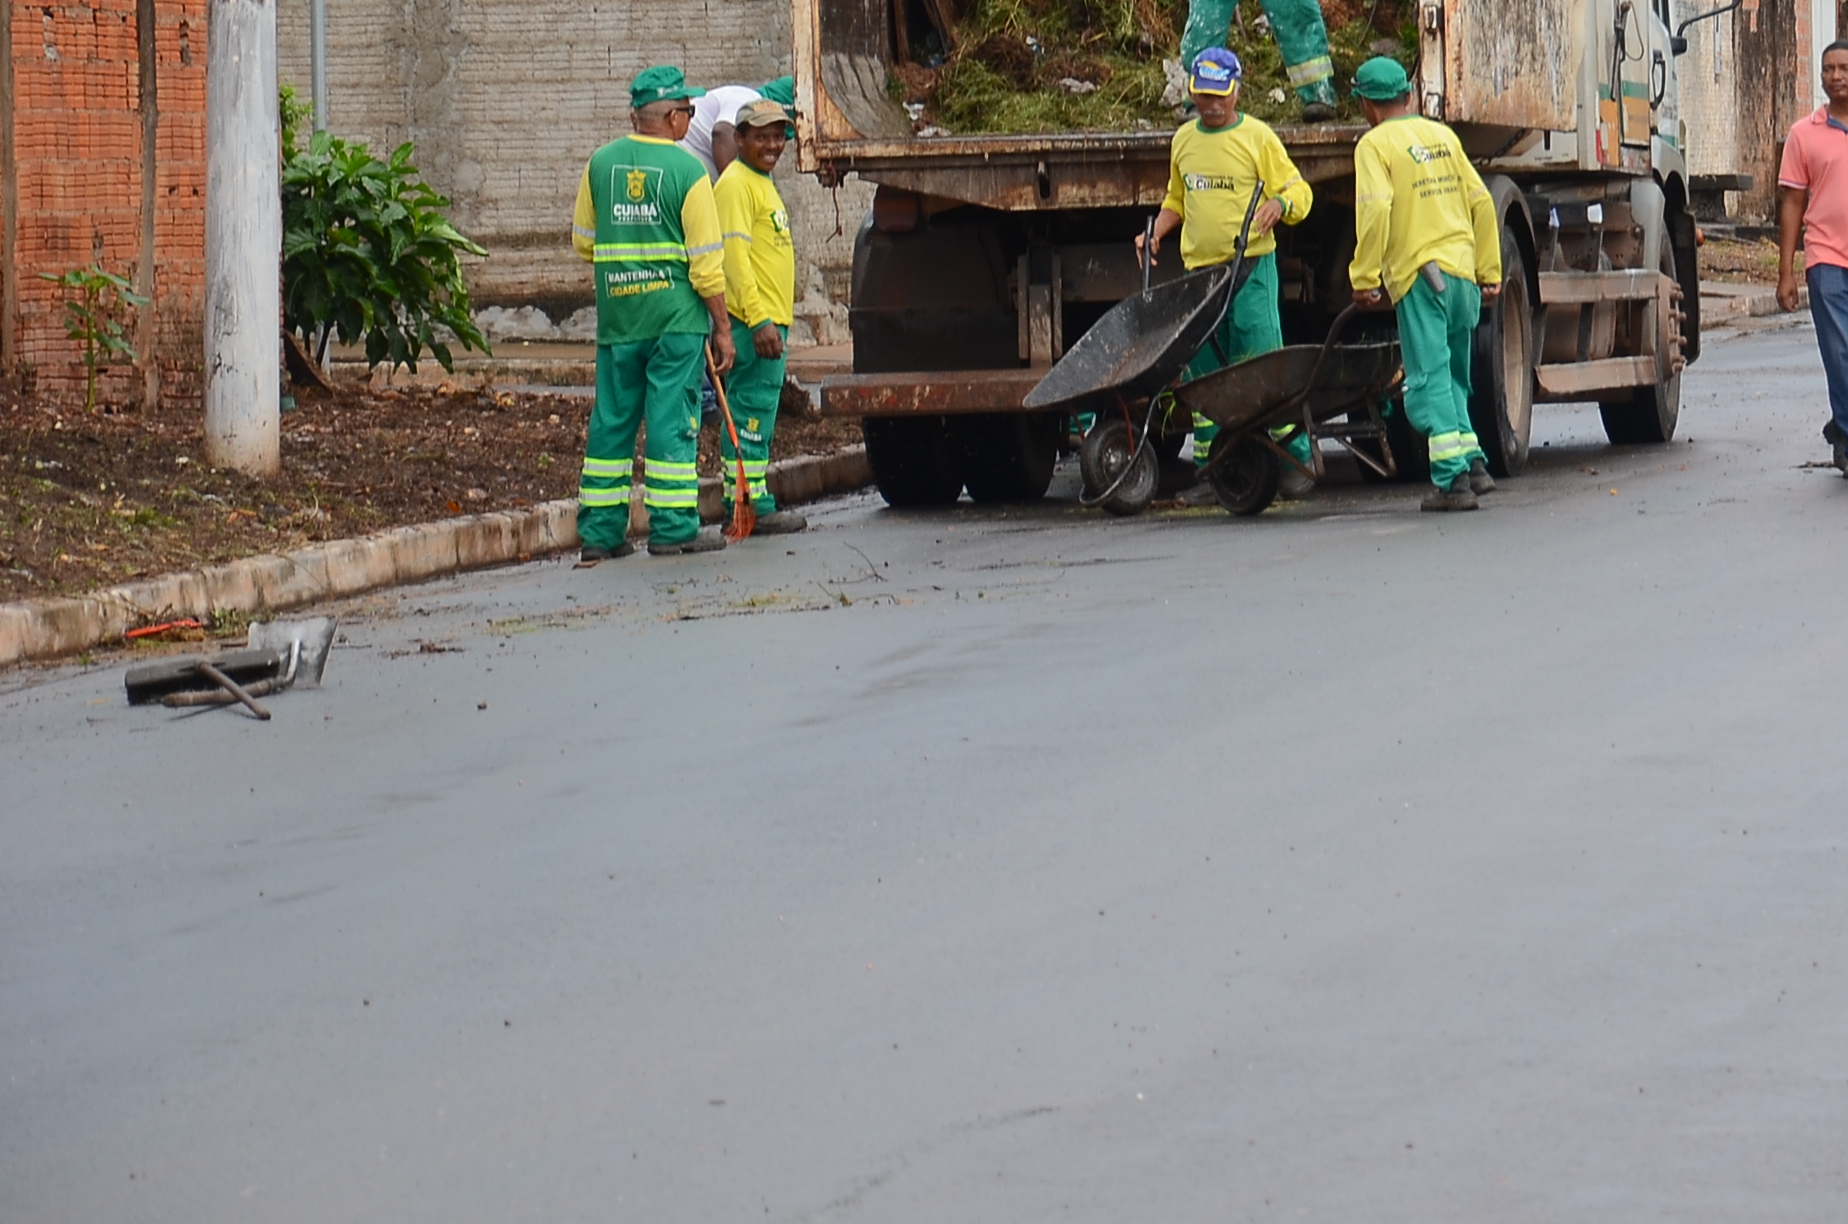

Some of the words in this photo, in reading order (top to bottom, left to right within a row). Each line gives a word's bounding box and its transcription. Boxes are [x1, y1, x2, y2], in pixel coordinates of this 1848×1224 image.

[613, 202, 658, 217] CUIABÁ
[610, 284, 641, 296] CIDADE
[642, 280, 670, 292] LIMPA
